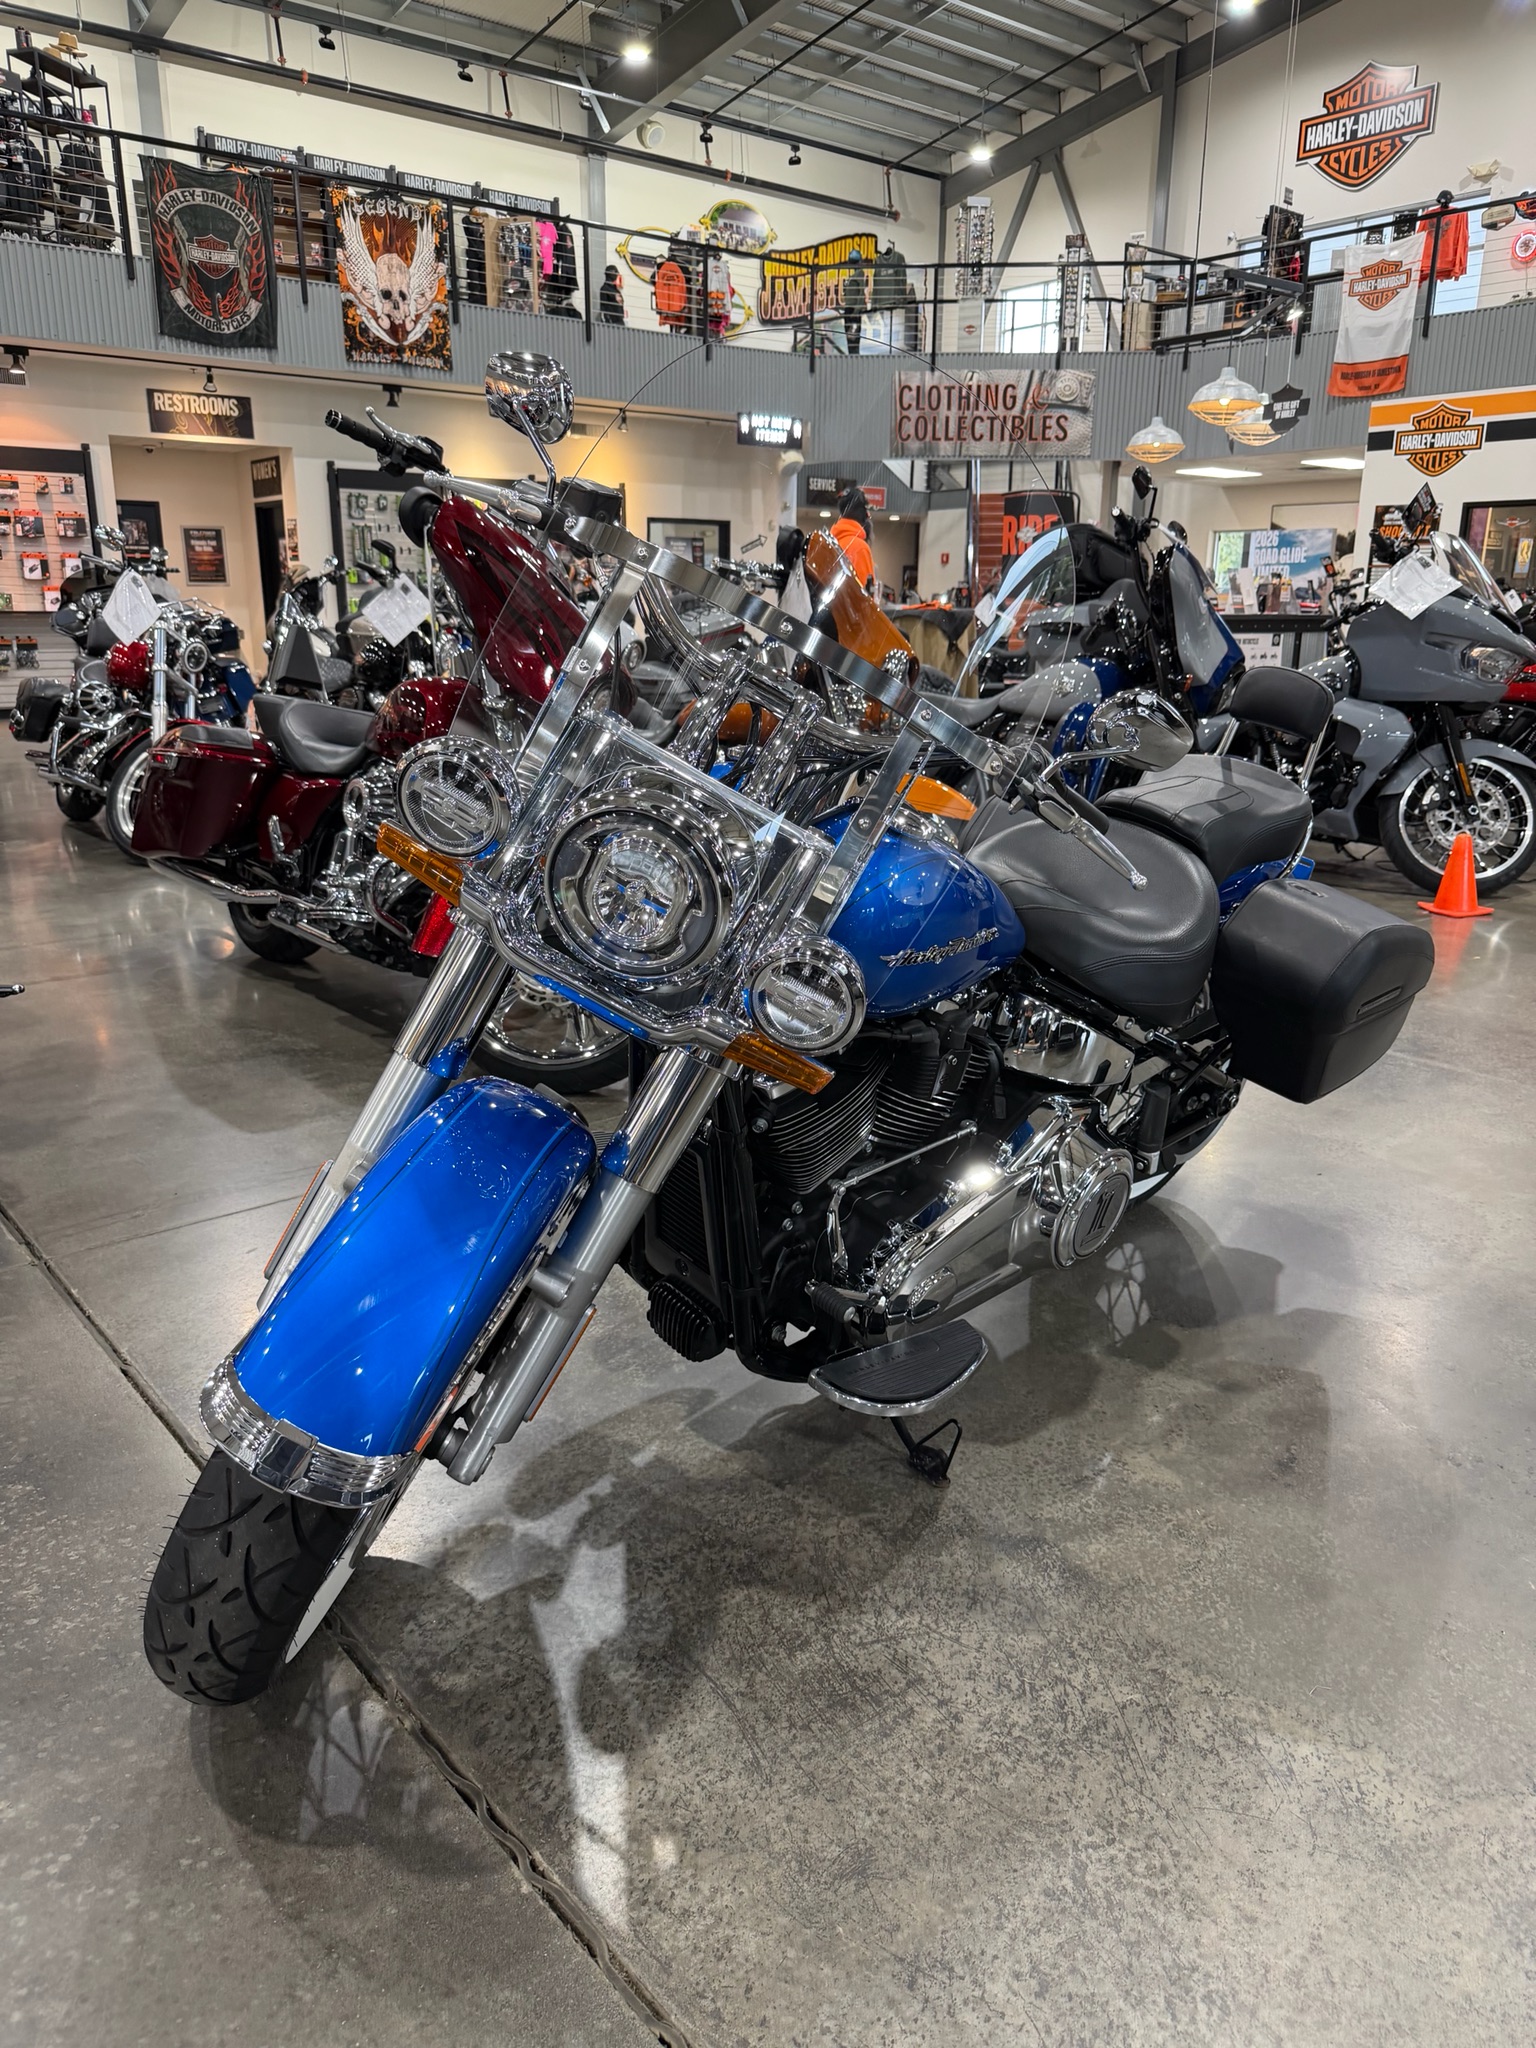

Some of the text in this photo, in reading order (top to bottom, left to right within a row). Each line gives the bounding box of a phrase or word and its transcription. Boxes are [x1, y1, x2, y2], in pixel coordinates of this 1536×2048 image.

[1335, 75, 1399, 111] MOTOR
[1305, 98, 1425, 151] HARLEY-DAVIDSON
[313, 156, 386, 181] HARLEY-DAVIDSON
[1329, 139, 1392, 177] CYCLES
[404, 174, 472, 199] HARLEY-DAVIDSON
[158, 190, 258, 235] HARLEY-DAVIDSON
[489, 190, 551, 213] HARLEY-DAVIDSON
[190, 248, 236, 263] HARLEY-DAVIDSON
[1366, 264, 1397, 277] MOTOR
[1353, 273, 1407, 293] HARLEY-DAVIDSON
[1364, 290, 1394, 307] CYCLES
[184, 303, 252, 332] MOTORCYCLES
[153, 392, 239, 417] RESTROOMS
[899, 384, 1017, 412] CLOTHING
[897, 414, 1069, 442] COLLECTIBLES
[1420, 411, 1462, 430] MOTOR
[1400, 430, 1478, 451] HARLEY-DAVIDSON
[252, 460, 277, 481] WOMEN'S
[1415, 451, 1457, 472] CYCLES
[809, 477, 837, 492] SERVICE
[1256, 531, 1280, 547] 2026
[1255, 547, 1307, 565] ROAD GLIDE
